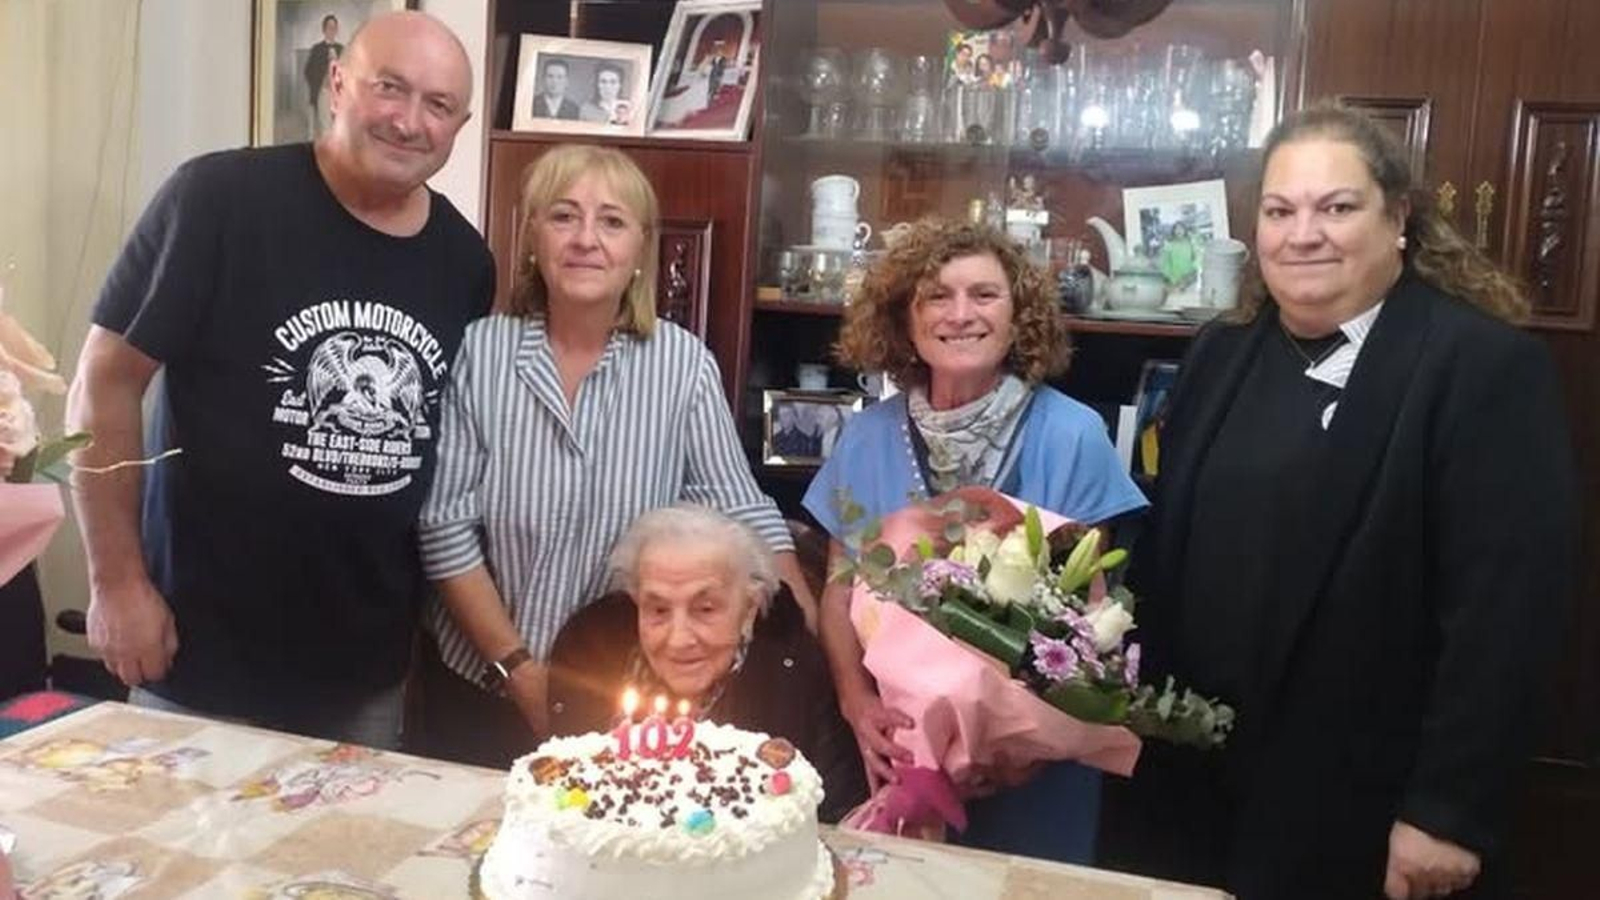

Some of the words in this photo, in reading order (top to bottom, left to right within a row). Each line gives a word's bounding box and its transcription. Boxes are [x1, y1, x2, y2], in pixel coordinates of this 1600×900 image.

[274, 299, 350, 351] CUSTOM
[354, 300, 448, 380] MOTORCYCLE
[307, 431, 328, 447] THE
[612, 716, 695, 761] 102
